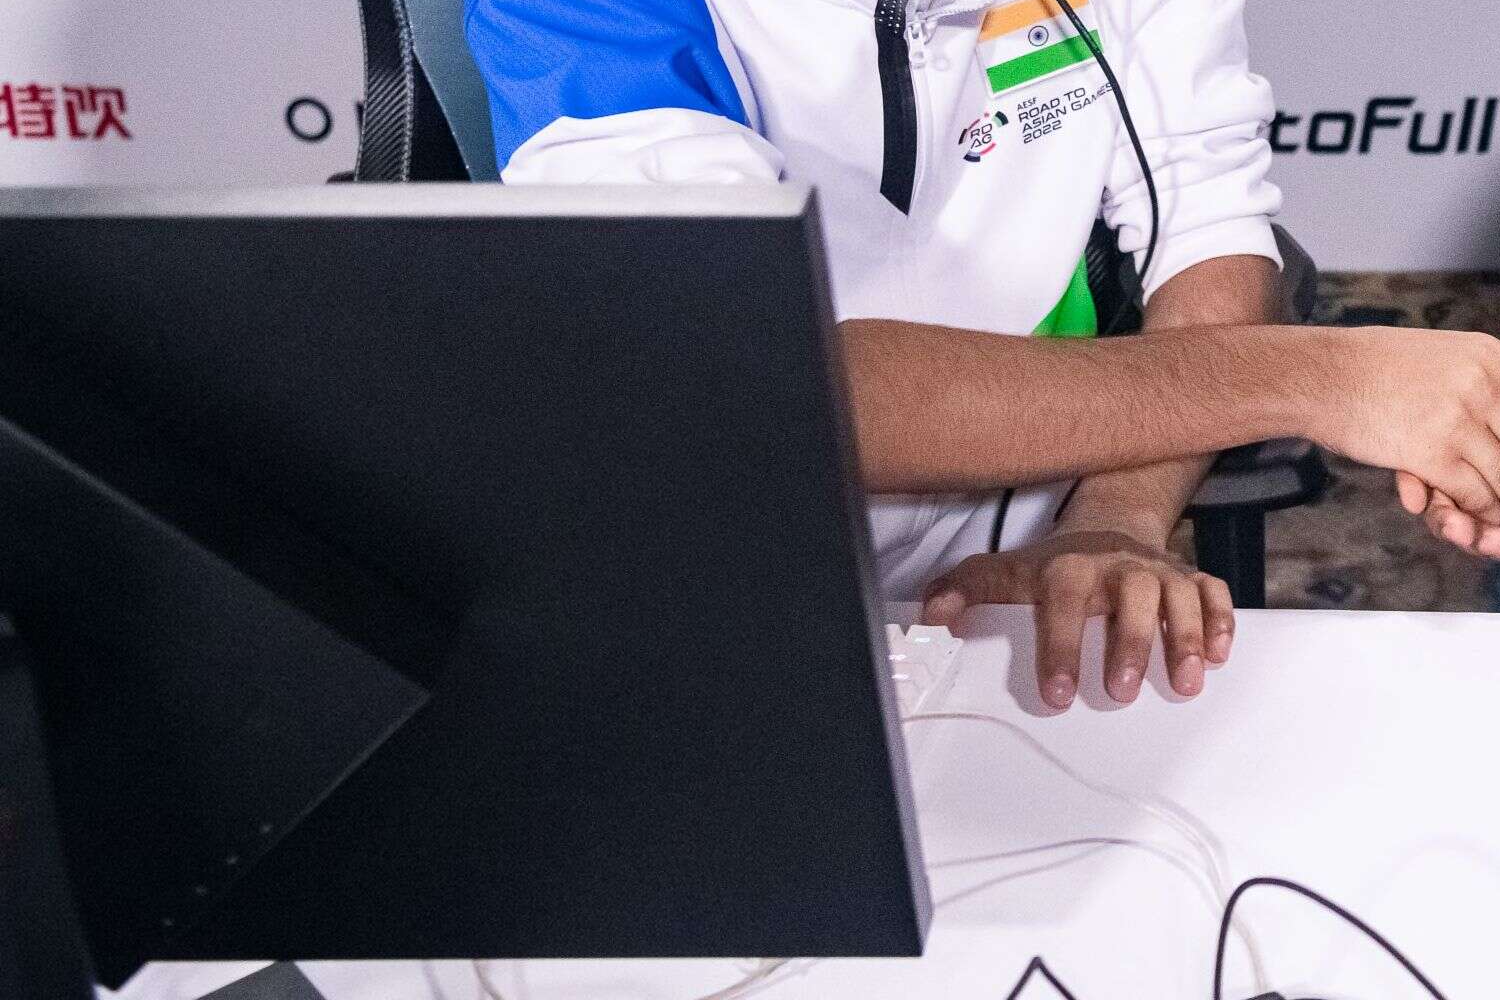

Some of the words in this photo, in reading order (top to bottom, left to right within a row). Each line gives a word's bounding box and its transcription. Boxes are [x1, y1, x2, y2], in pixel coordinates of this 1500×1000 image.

[1017, 97, 1038, 111] AESF
[1018, 98, 1060, 123] ROAD
[1064, 87, 1086, 102] TO
[1022, 106, 1067, 134] ASIAN
[1023, 120, 1062, 144] 2022
[1268, 96, 1500, 155] toFull
